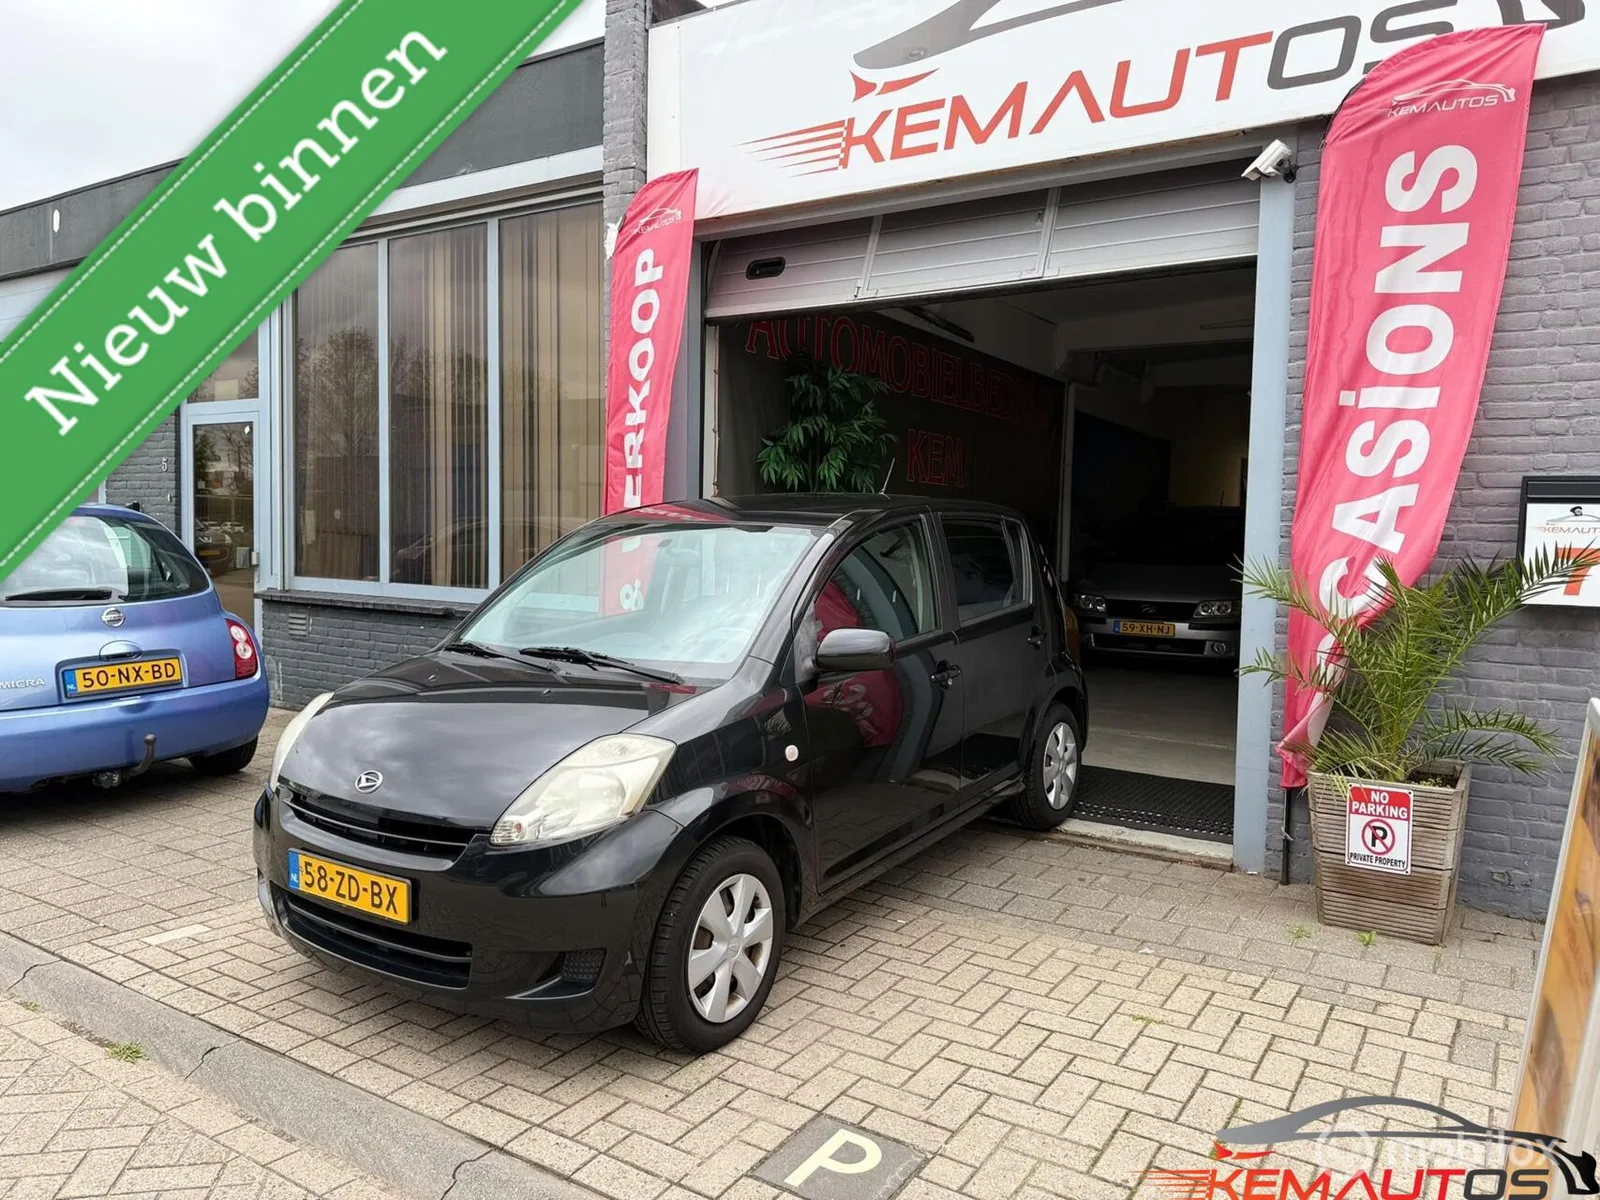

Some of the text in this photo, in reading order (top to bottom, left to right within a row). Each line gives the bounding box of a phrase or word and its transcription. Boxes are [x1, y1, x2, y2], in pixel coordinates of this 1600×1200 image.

[838, 0, 1458, 169] KEMAUTOS
[1387, 95, 1498, 118] KEMAUTOS
[906, 427, 965, 488] KEM
[1122, 623, 1170, 635] 59-XH-NJ
[0, 678, 46, 689] MICRA
[82, 662, 175, 689] 50-NX-BD
[1370, 790, 1389, 804] NO
[1352, 801, 1408, 819] PARKING
[1350, 852, 1406, 869] PRIVATE PROPERTY
[304, 861, 398, 915] 58-ZD-BX
[783, 1128, 883, 1188] P
